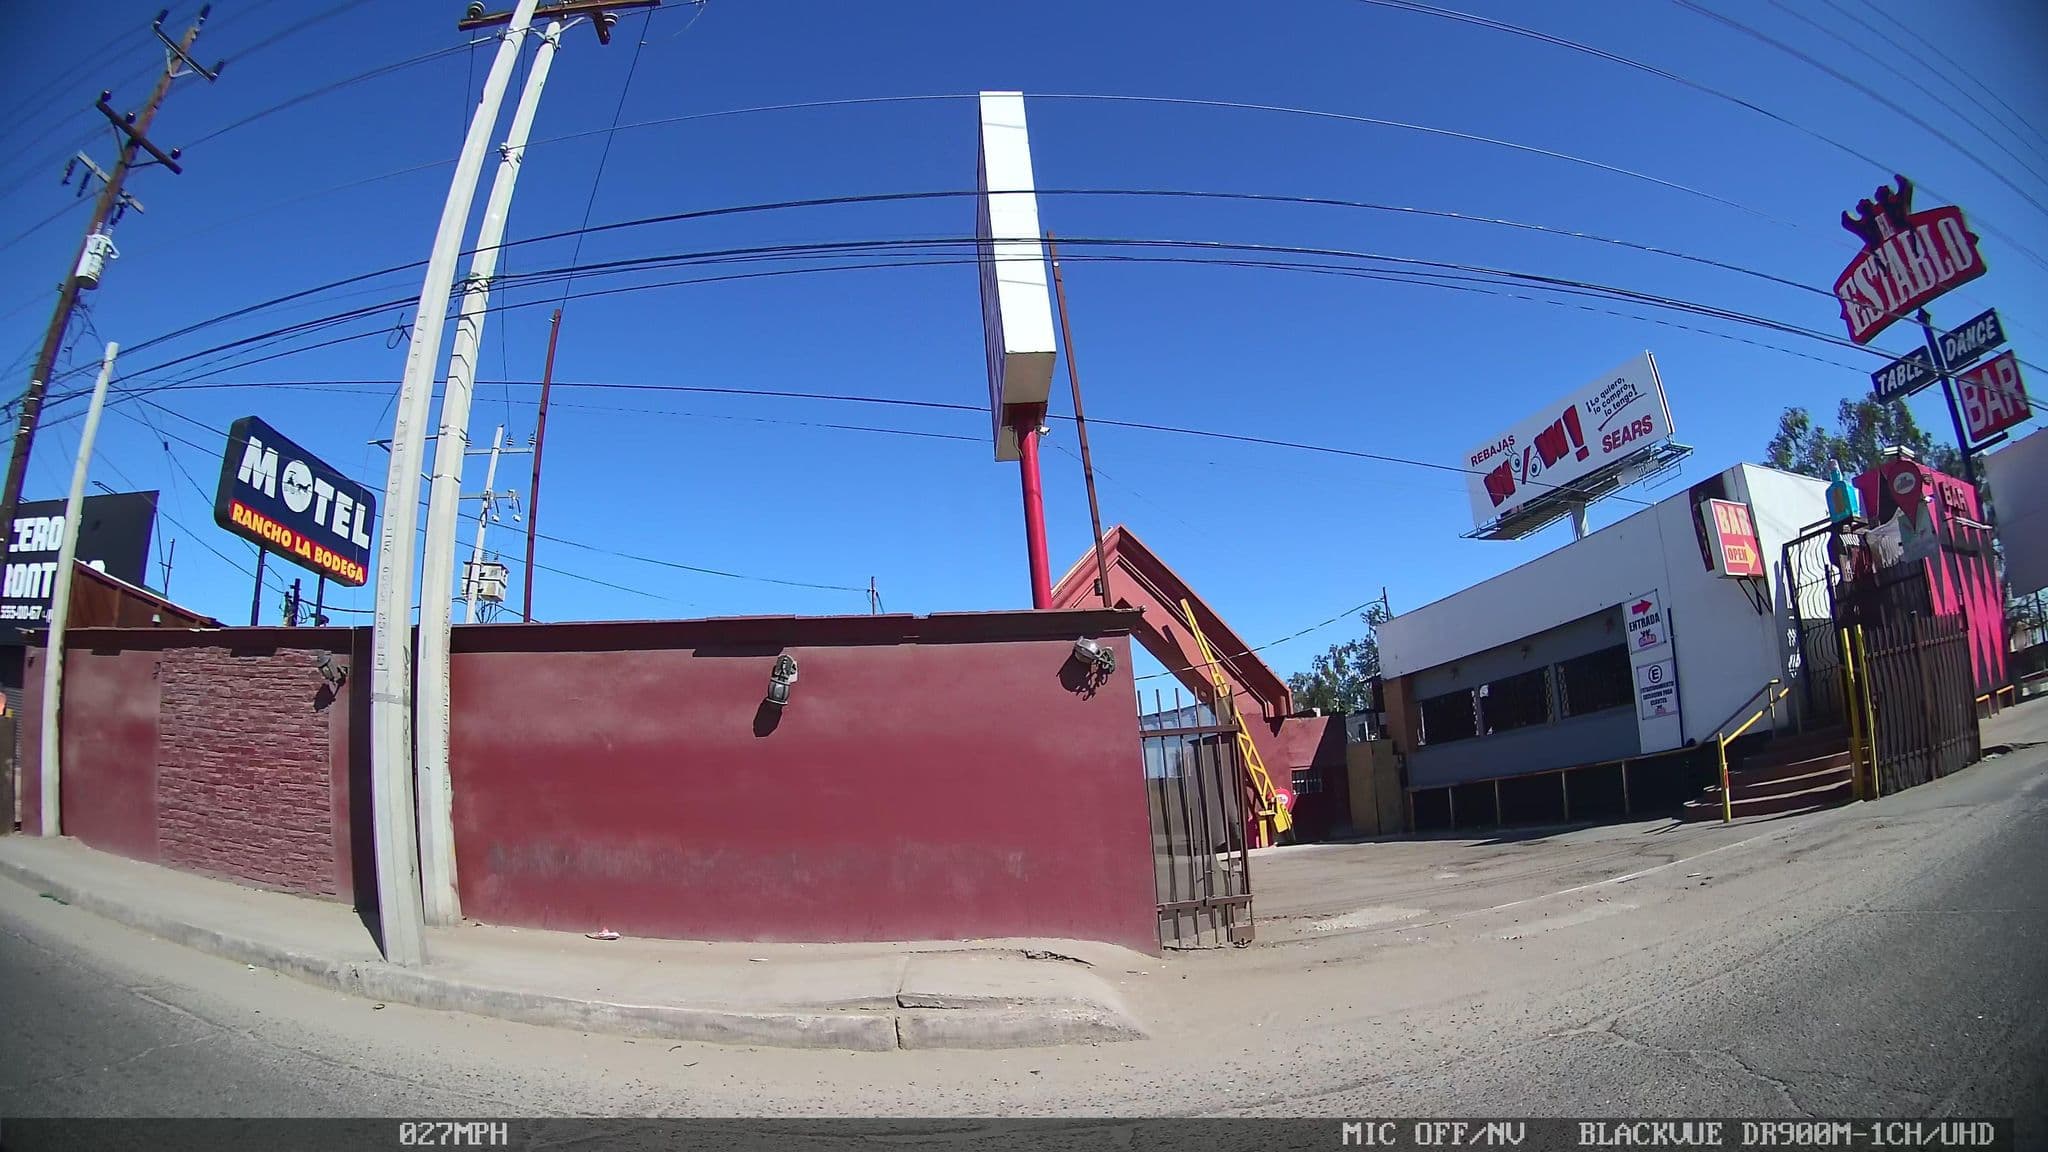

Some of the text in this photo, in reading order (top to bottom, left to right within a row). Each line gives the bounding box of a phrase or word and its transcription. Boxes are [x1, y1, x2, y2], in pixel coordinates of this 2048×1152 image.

[1839, 217, 1973, 336] ESTABLO
[1878, 319, 1996, 396] TABLE DANCE
[1959, 360, 2025, 434] BAR
[1470, 434, 1516, 468] REBAJAS
[1602, 414, 1653, 454] SEARS
[237, 435, 370, 550] MOTEL
[1714, 503, 1752, 537] BAR
[232, 502, 364, 583] RANCHO LA BODEGA
[1727, 547, 1749, 561] OPEN
[1628, 612, 1661, 633] ENTRADA
